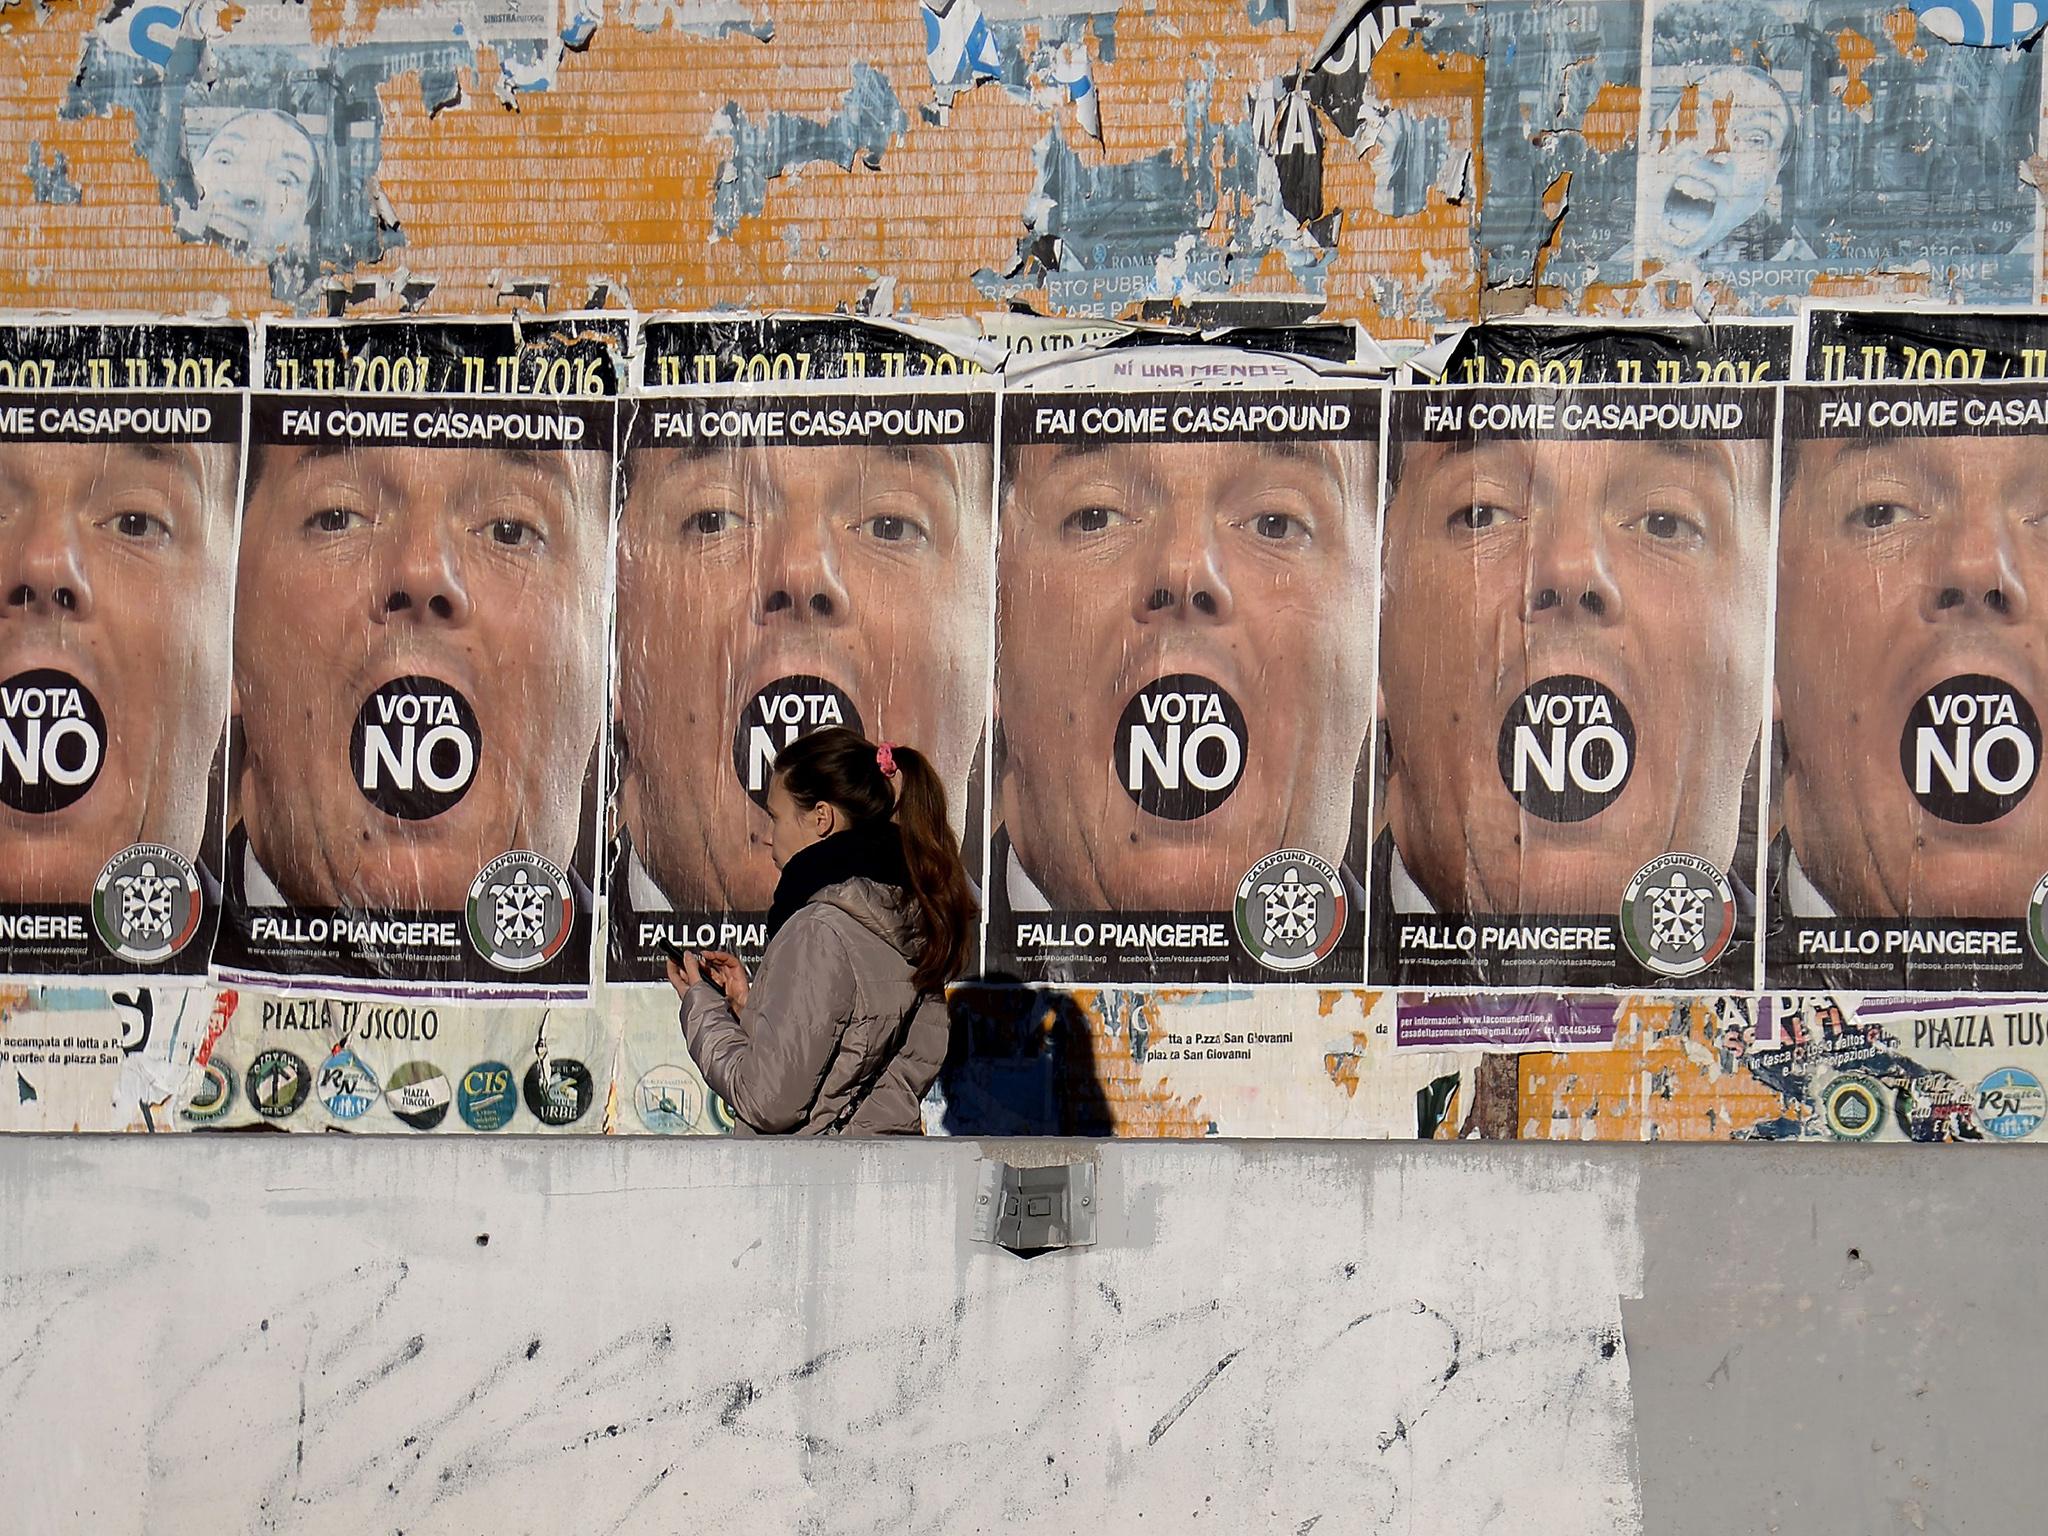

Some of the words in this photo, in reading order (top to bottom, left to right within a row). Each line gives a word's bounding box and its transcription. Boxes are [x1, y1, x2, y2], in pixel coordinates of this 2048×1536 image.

[1991, 219, 2013, 232] 419
[1846, 244, 1890, 259] ROMA
[1141, 363, 1185, 378] UNA
[1190, 363, 1290, 378] MENOS
[40, 407, 212, 434] CASAPOUND
[282, 410, 321, 436] FAI
[326, 410, 408, 438] COME
[413, 412, 586, 441] CASAPOUND
[653, 412, 693, 437] FAI
[700, 410, 784, 437] COME
[789, 408, 966, 437] CASAPOUND
[1034, 407, 1075, 435] FAI
[1081, 407, 1167, 434] COME
[1172, 404, 1352, 433] CASAPOUND
[1424, 405, 1463, 432] FAI
[1468, 403, 1556, 431] COME
[1562, 402, 1744, 431] CASAPOUND
[1819, 401, 1862, 428] FAI
[1867, 400, 1959, 428] COME
[1963, 399, 2048, 427] CASA
[1, 687, 86, 719] VOTA
[376, 694, 461, 726] VOTA
[758, 693, 844, 725] VOTA
[1140, 692, 1226, 724] VOTA
[1524, 694, 1614, 725] VOTA
[1927, 694, 2019, 725] VOTA
[0, 716, 101, 786] NO
[362, 724, 474, 793] NO
[1128, 722, 1242, 792] NO
[1512, 725, 1629, 793] NO
[1915, 724, 2036, 795] NO
[105, 847, 164, 876] CASAPOUND
[164, 849, 192, 877] ITALIA
[479, 853, 536, 884] CASAPOUND
[536, 859, 564, 885] ITALIA
[1246, 852, 1307, 884] CASAPOUND
[1307, 856, 1335, 883] ITALIA
[1634, 854, 1695, 887] CASAPOUND
[1695, 860, 1723, 888] ITALIA
[251, 917, 329, 942] FALLO
[332, 919, 462, 946] PIANGERE.
[638, 923, 716, 947] FALLO
[1016, 923, 1095, 948] FALLO
[1099, 923, 1230, 948] PIANGERE.
[1399, 925, 1477, 950] FALLO
[1481, 926, 1616, 951] PIANGERE.
[1798, 930, 1880, 954] FALLO
[1884, 930, 2024, 954] PIANGERE.
[262, 999, 332, 1031] PIAZZA
[1376, 1023, 1389, 1035] da
[1400, 1018, 1413, 1028] per
[63, 1036, 74, 1048] di
[76, 1037, 99, 1050] lotta
[1223, 1033, 1244, 1045] San
[1915, 1015, 1995, 1049] PIAZZA
[2004, 1012, 2048, 1046] TUS
[48, 1053, 61, 1064] da
[63, 1053, 97, 1066] piazza
[99, 1053, 119, 1065] San
[1183, 1049, 1203, 1061] San
[1206, 1048, 1251, 1061] Giovanni
[1763, 1051, 1792, 1066] tasca
[402, 1087, 430, 1098] PIAZZA
[463, 1070, 509, 1096] CIS
